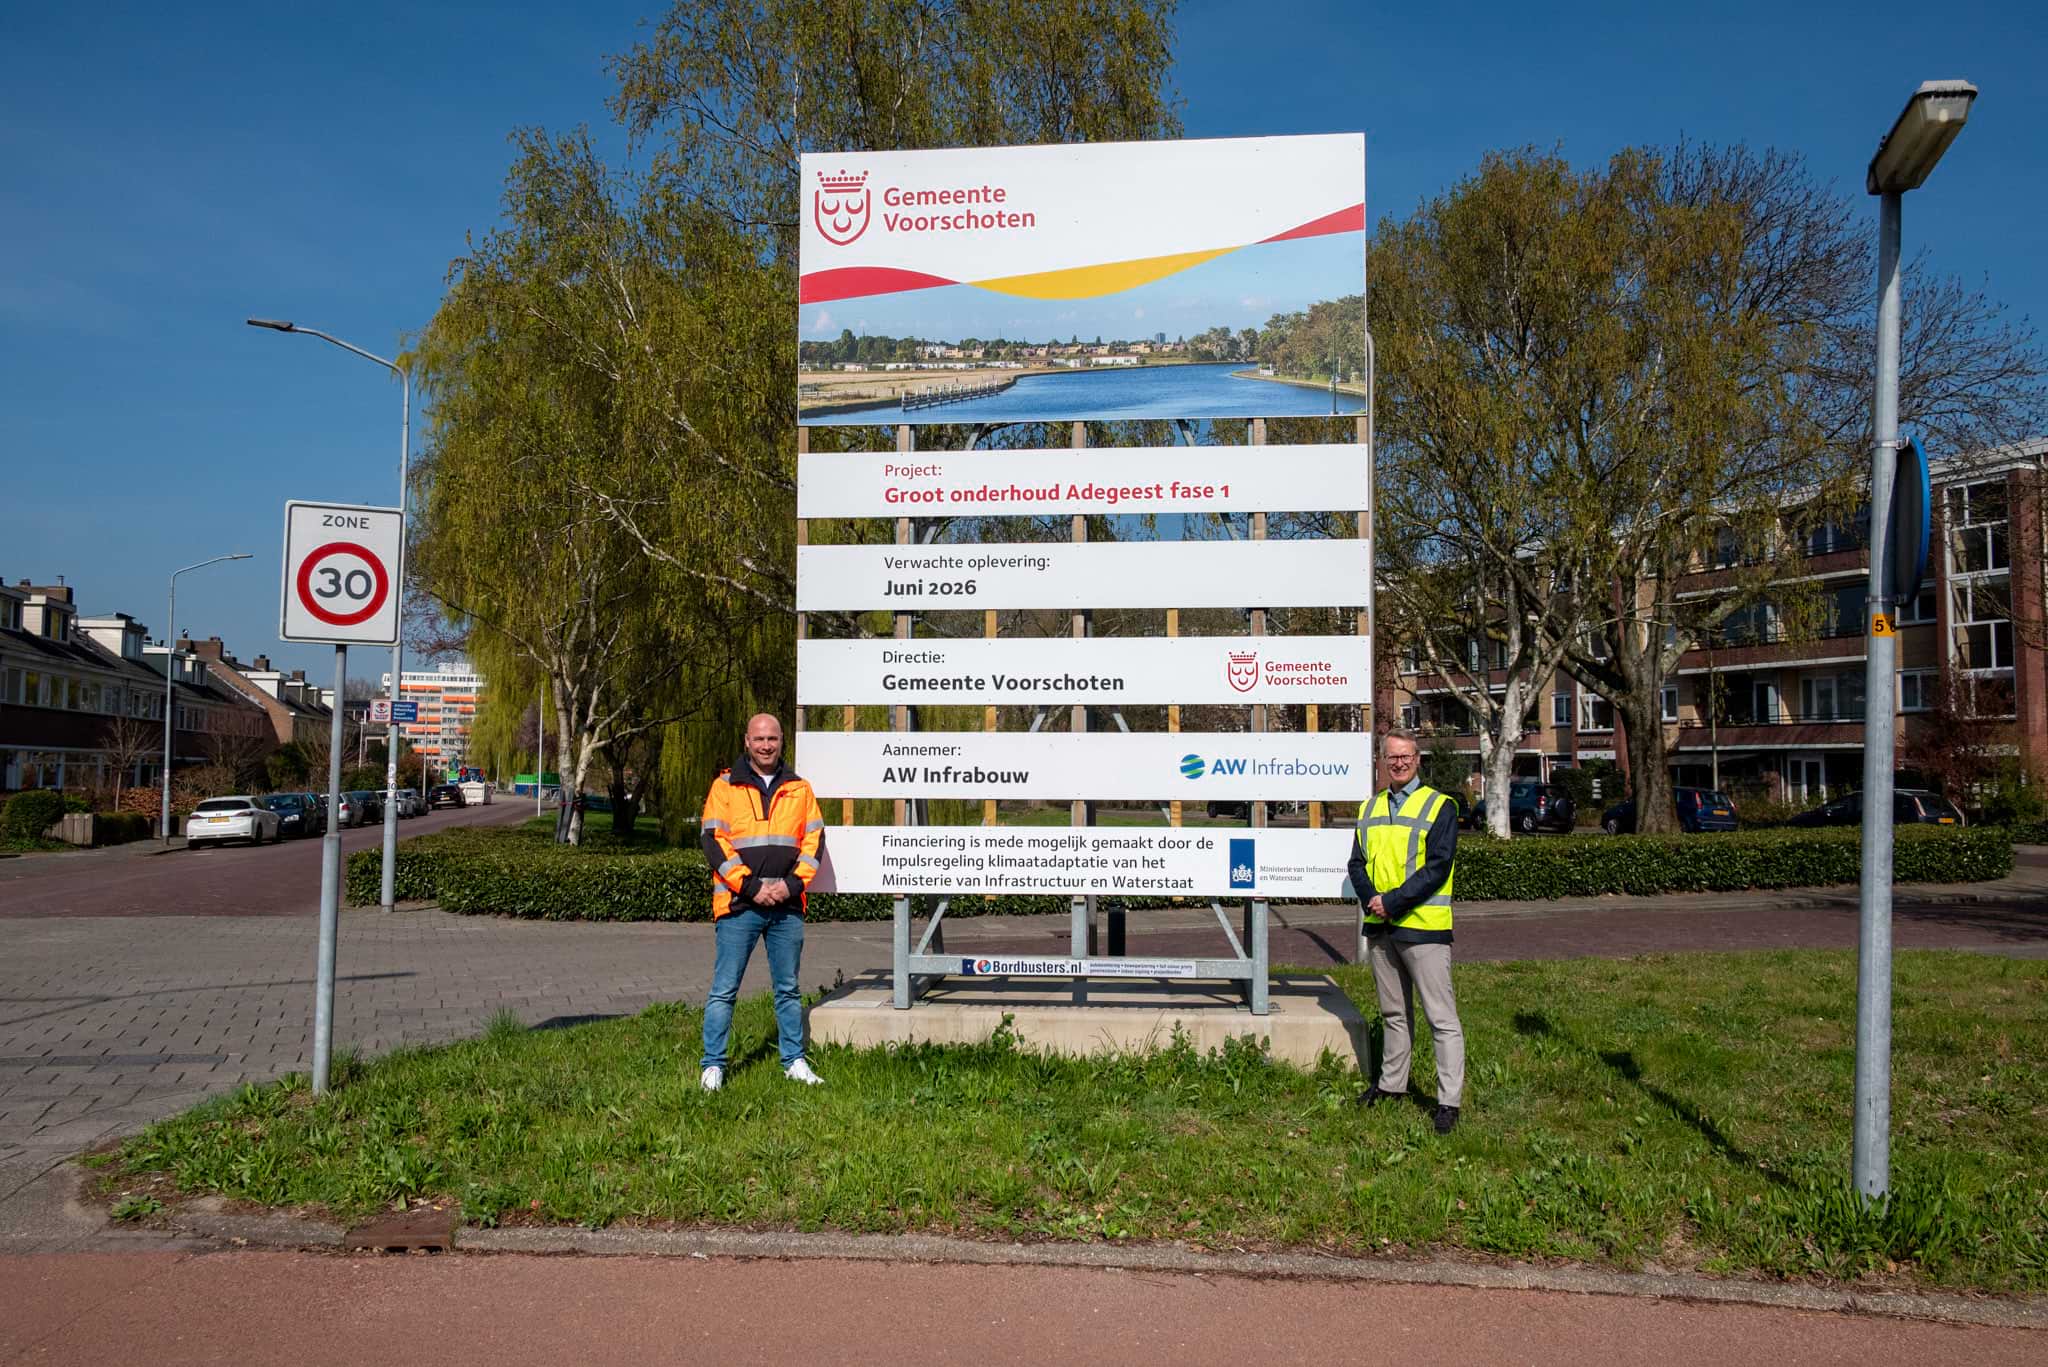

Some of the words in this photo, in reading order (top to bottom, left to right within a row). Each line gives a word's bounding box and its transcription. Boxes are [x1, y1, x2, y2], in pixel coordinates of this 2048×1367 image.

[884, 185, 1006, 206] Gemeente
[884, 208, 1035, 232] Voorschoten
[885, 464, 941, 480] Project:
[885, 488, 944, 503] Groot
[951, 484, 1059, 502] onderhoud
[1066, 483, 1163, 504] Adegeest
[1170, 482, 1214, 498] fase
[1221, 485, 1229, 497] 1
[322, 514, 370, 529] ZONE
[884, 556, 963, 568] Verwachte
[968, 555, 1050, 571] oplevering:
[315, 567, 372, 600] 30
[884, 579, 922, 595] Juni
[929, 580, 976, 595] 2026
[883, 651, 944, 663] Directie:
[1265, 660, 1331, 672] Gemeente
[883, 674, 985, 690] Gemeente
[992, 674, 1124, 690] Voorschoten
[1265, 671, 1347, 685] Voorschoten
[883, 744, 960, 756] Aannemer:
[883, 768, 917, 783] AW
[924, 766, 1029, 783] Infrabouw
[1211, 759, 1247, 775] AW
[1253, 758, 1349, 775] Infrabouw
[883, 835, 965, 851] Financiering
[970, 836, 980, 847] is
[985, 835, 1023, 848] mede
[1028, 835, 1086, 851] mogelijk
[1092, 836, 1153, 852] gemaakt
[1158, 836, 1192, 849] door
[1197, 837, 1213, 849] de
[883, 854, 983, 870] Impulsregeling
[989, 855, 1108, 871] klimaatadaptatie
[1113, 859, 1137, 868] van
[1143, 856, 1165, 868] het
[1259, 865, 1292, 873] Ministerie
[883, 874, 951, 886] Ministerie
[956, 877, 980, 886] van
[986, 874, 1086, 887] Infrastructuur
[1091, 879, 1107, 888] en
[1112, 876, 1193, 888] Waterstaat
[1269, 874, 1303, 882] Waterstaat
[993, 959, 1082, 974] Bordbusters.nl
